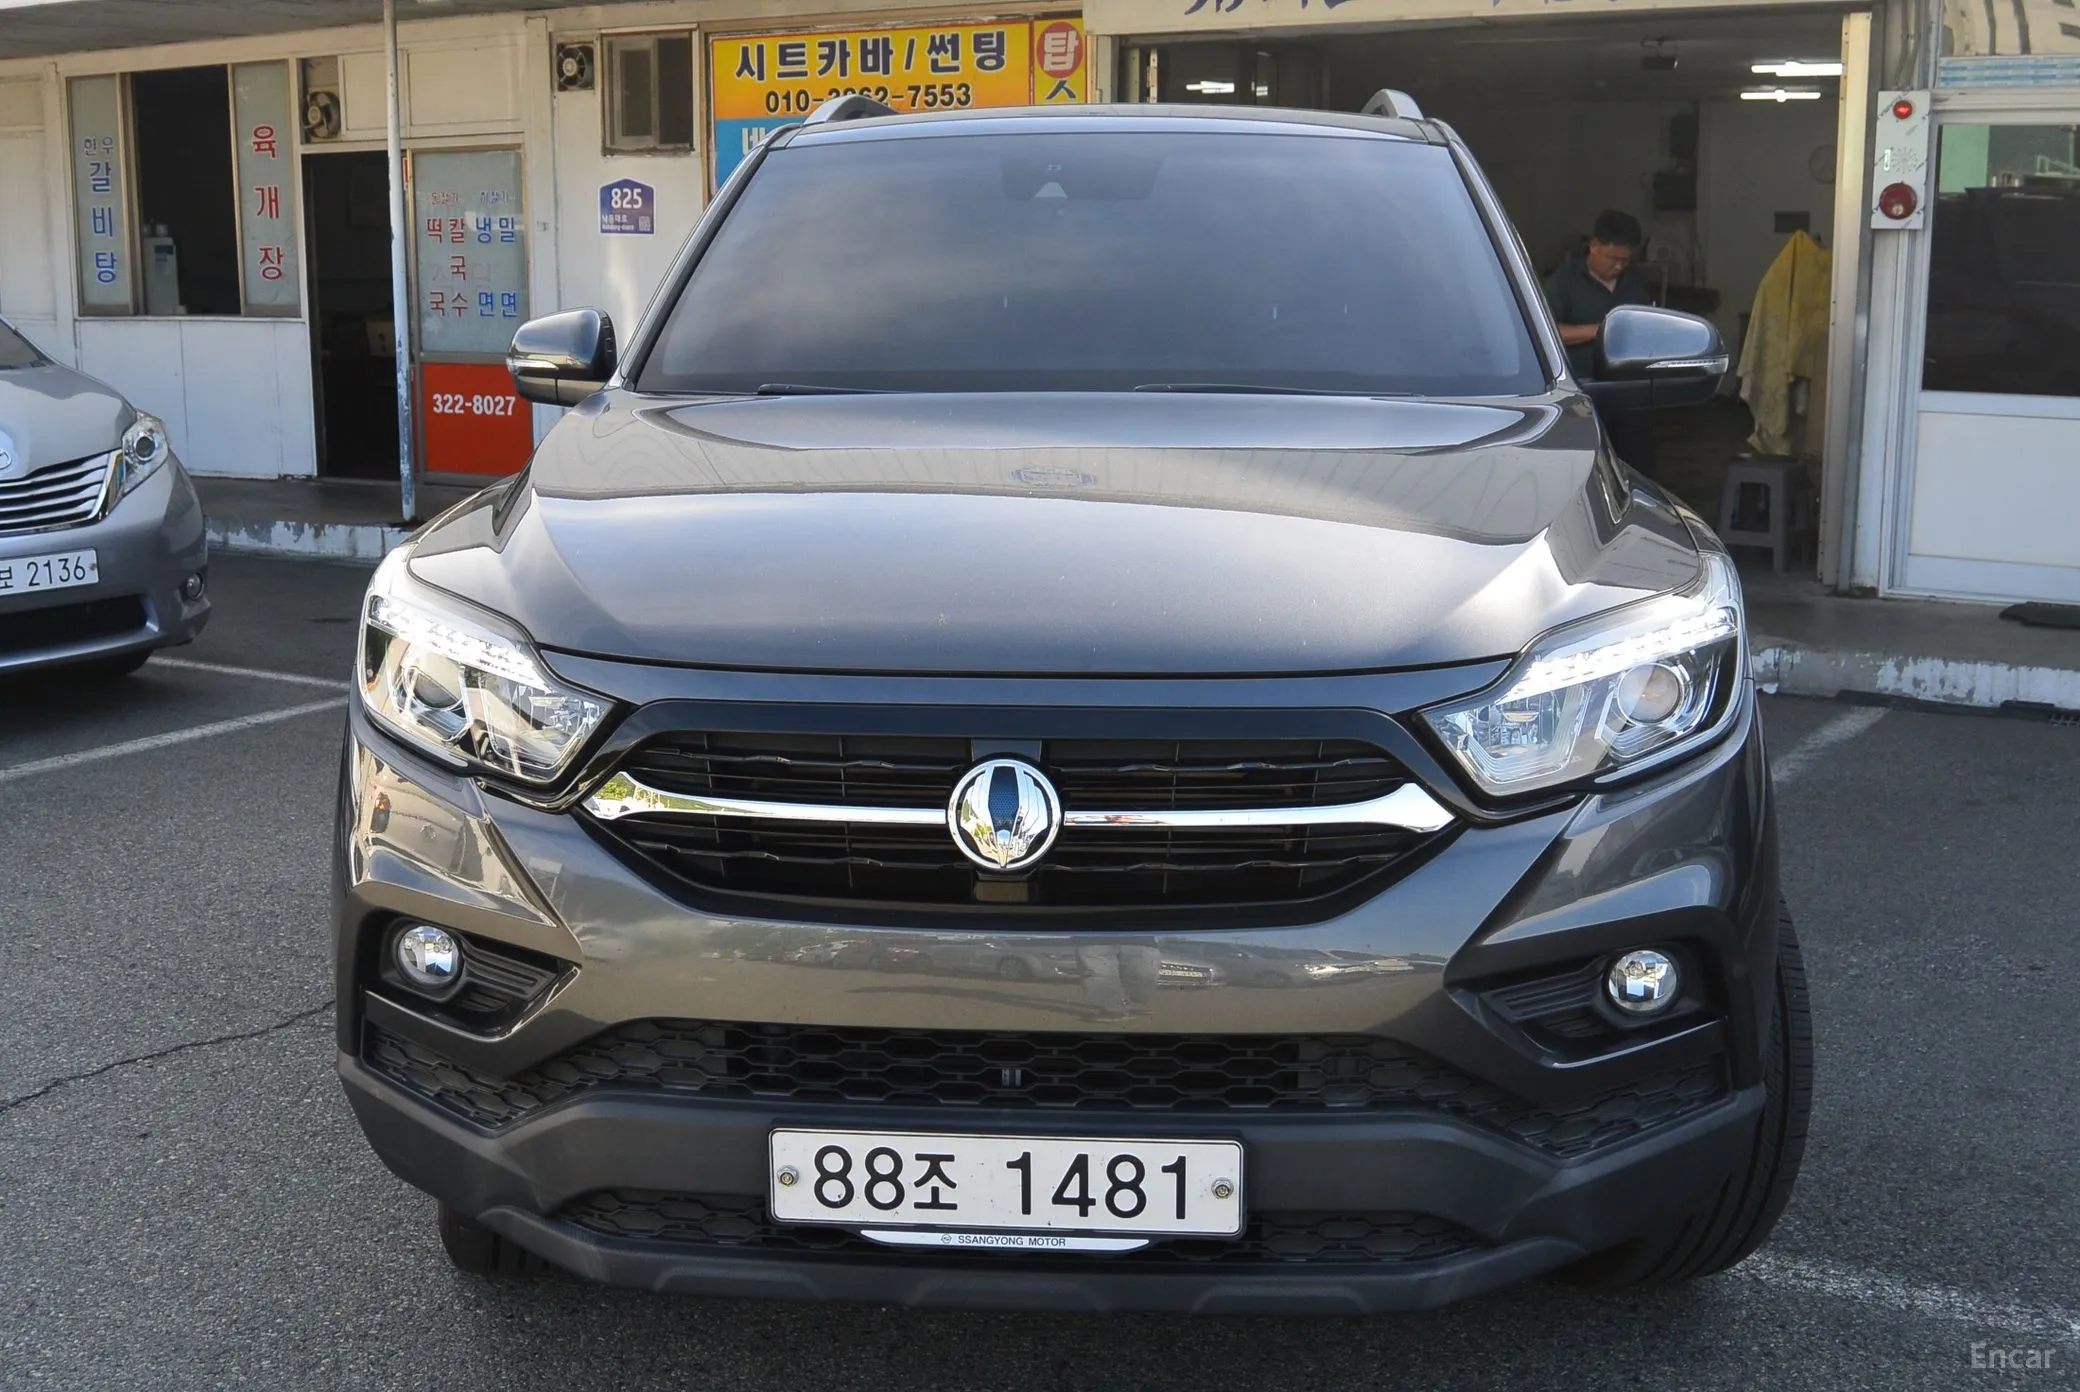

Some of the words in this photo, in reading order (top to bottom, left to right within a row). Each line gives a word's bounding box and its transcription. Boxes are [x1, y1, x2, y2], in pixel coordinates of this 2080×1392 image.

[252, 125, 284, 280] 육개장
[611, 188, 642, 209] 825
[89, 161, 117, 284] 갈비탕
[432, 393, 516, 416] 322-8027
[26, 556, 86, 587] 2136
[813, 1145, 958, 1210] 88조
[1005, 1151, 1187, 1220] 1481
[957, 1234, 1024, 1247] SSANGYONG
[1028, 1237, 1067, 1247] MOTOR
